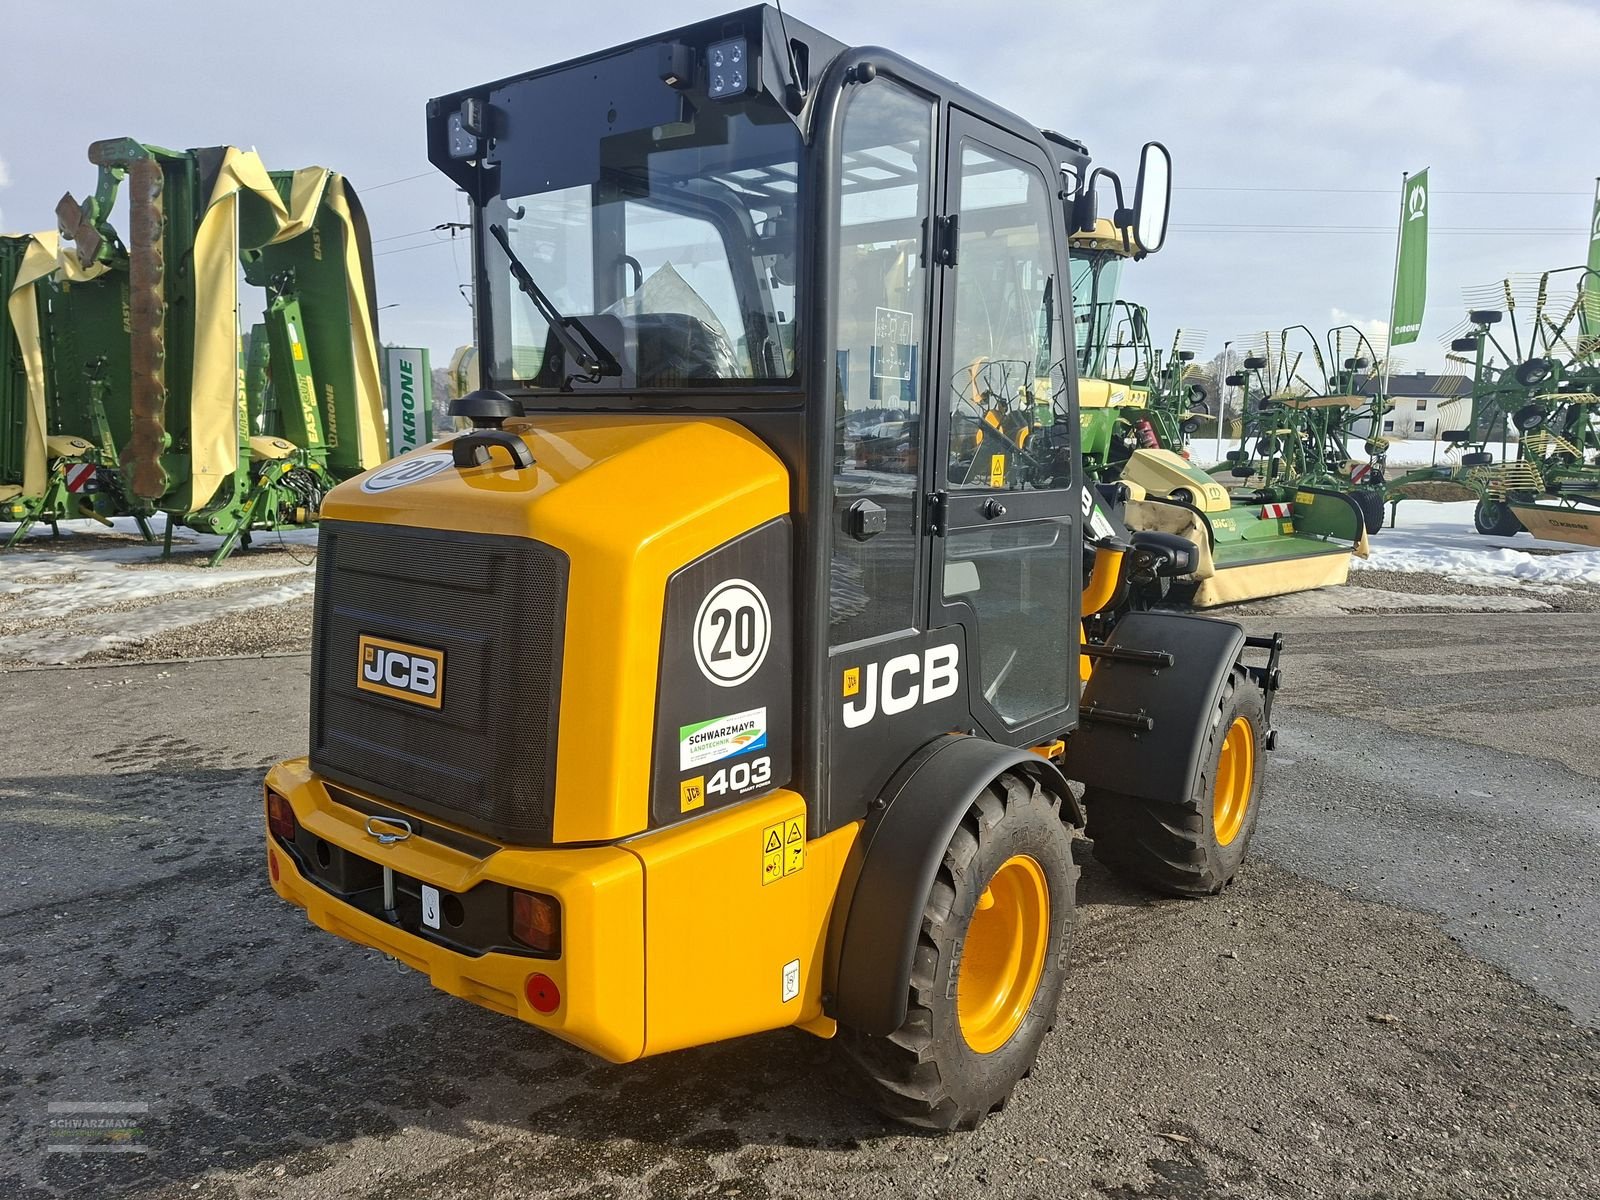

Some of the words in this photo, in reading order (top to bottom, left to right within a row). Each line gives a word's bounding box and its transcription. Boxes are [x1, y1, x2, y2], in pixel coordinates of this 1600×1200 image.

[325, 384, 337, 433] KRONE
[399, 359, 417, 445] KRONE
[376, 460, 439, 480] 20
[710, 605, 756, 662] 20
[364, 649, 436, 694] JCB
[843, 643, 959, 729] JCB
[689, 720, 755, 745] SCHWARZMAYR
[690, 738, 730, 753] LANDTECHNIK
[686, 786, 700, 802] JCB
[706, 755, 772, 795] 403
